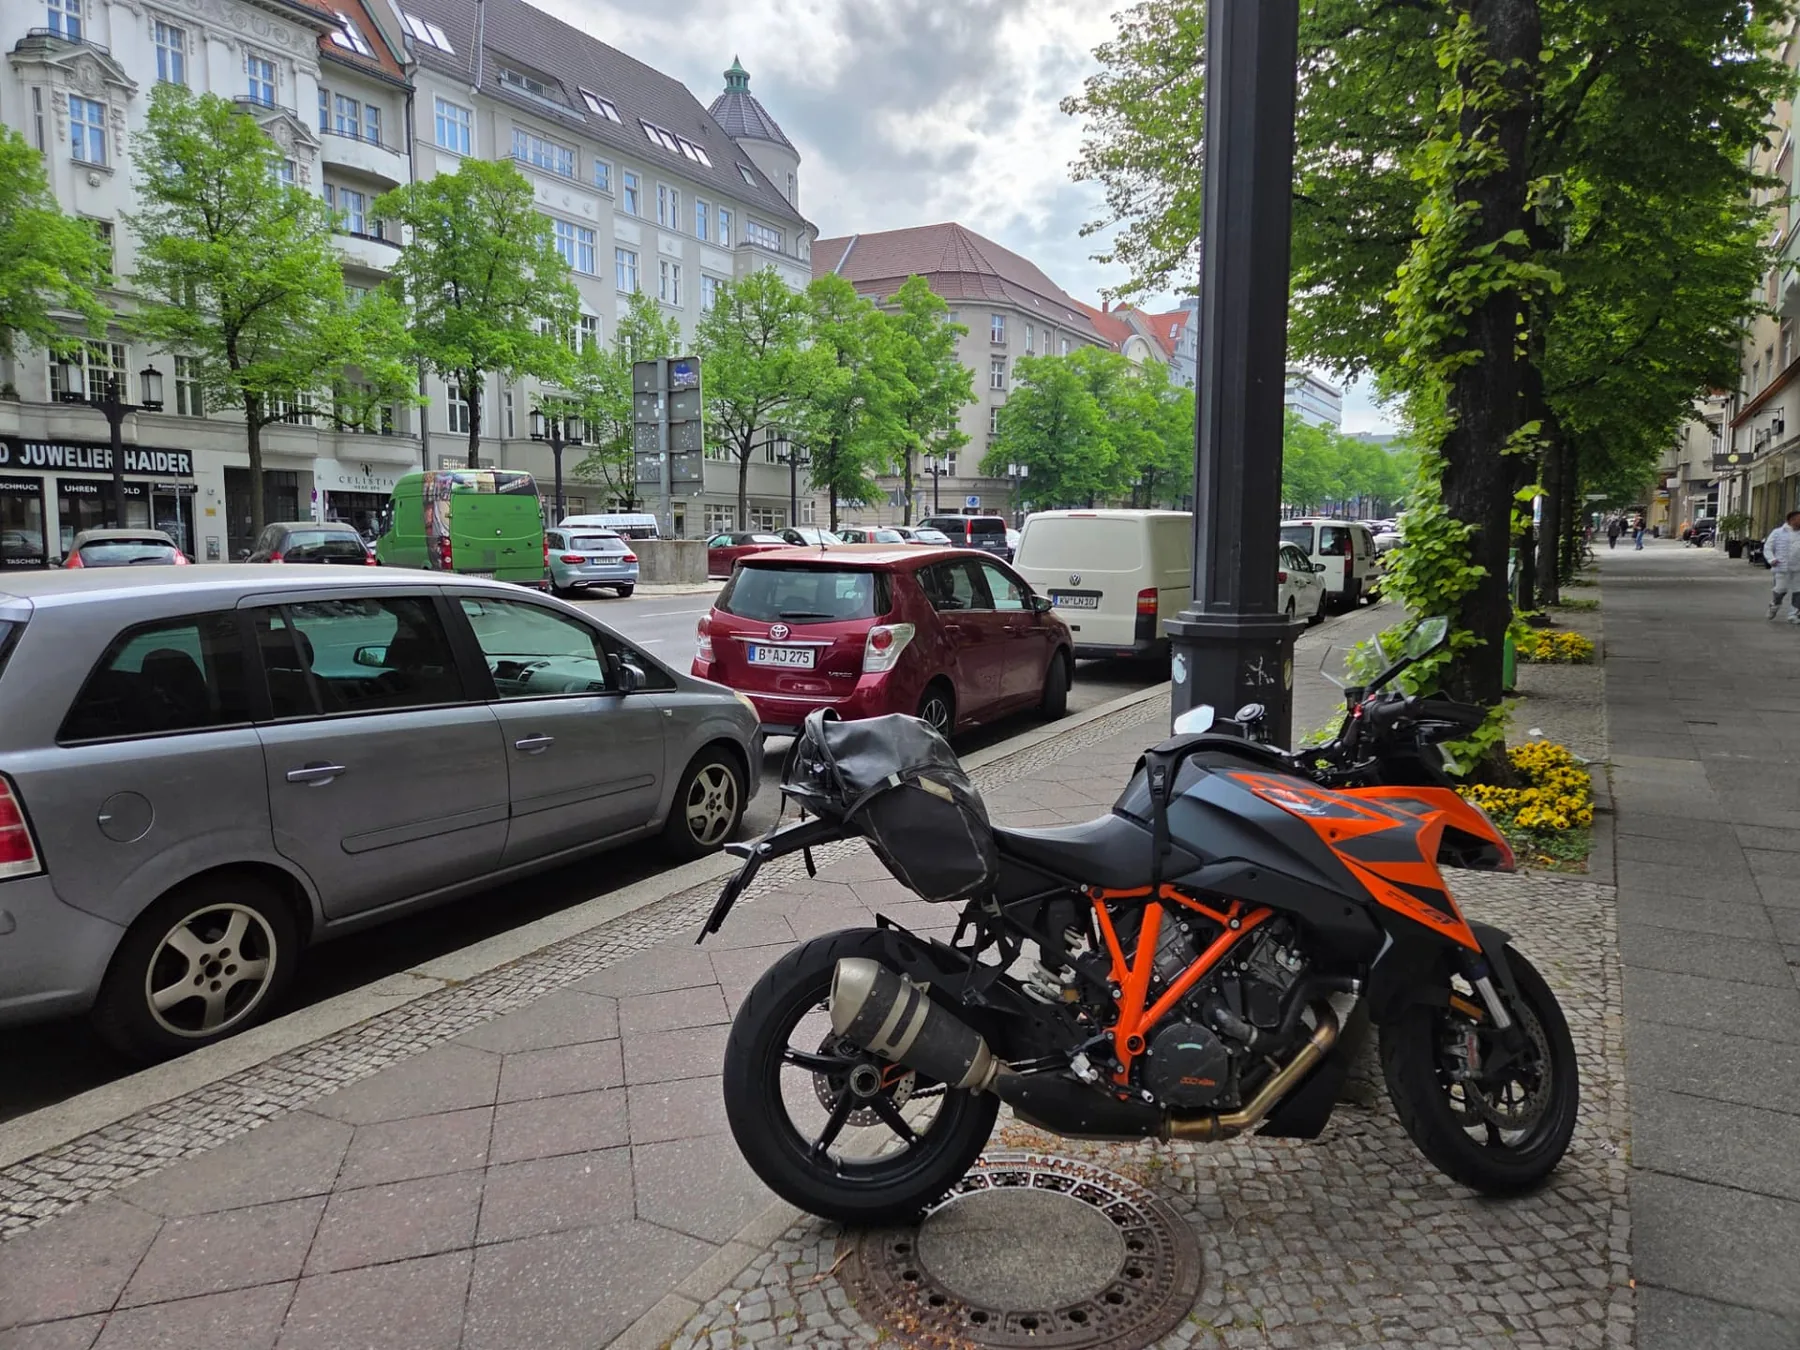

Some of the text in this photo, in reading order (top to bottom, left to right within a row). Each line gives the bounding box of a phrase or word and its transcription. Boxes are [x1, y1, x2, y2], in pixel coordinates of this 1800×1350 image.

[19, 444, 113, 469] JUWELIER
[123, 450, 191, 473] HAIDER
[338, 475, 395, 486] CELISTIA
[64, 485, 98, 493] UHREN
[758, 648, 810, 664] B AJ 275
